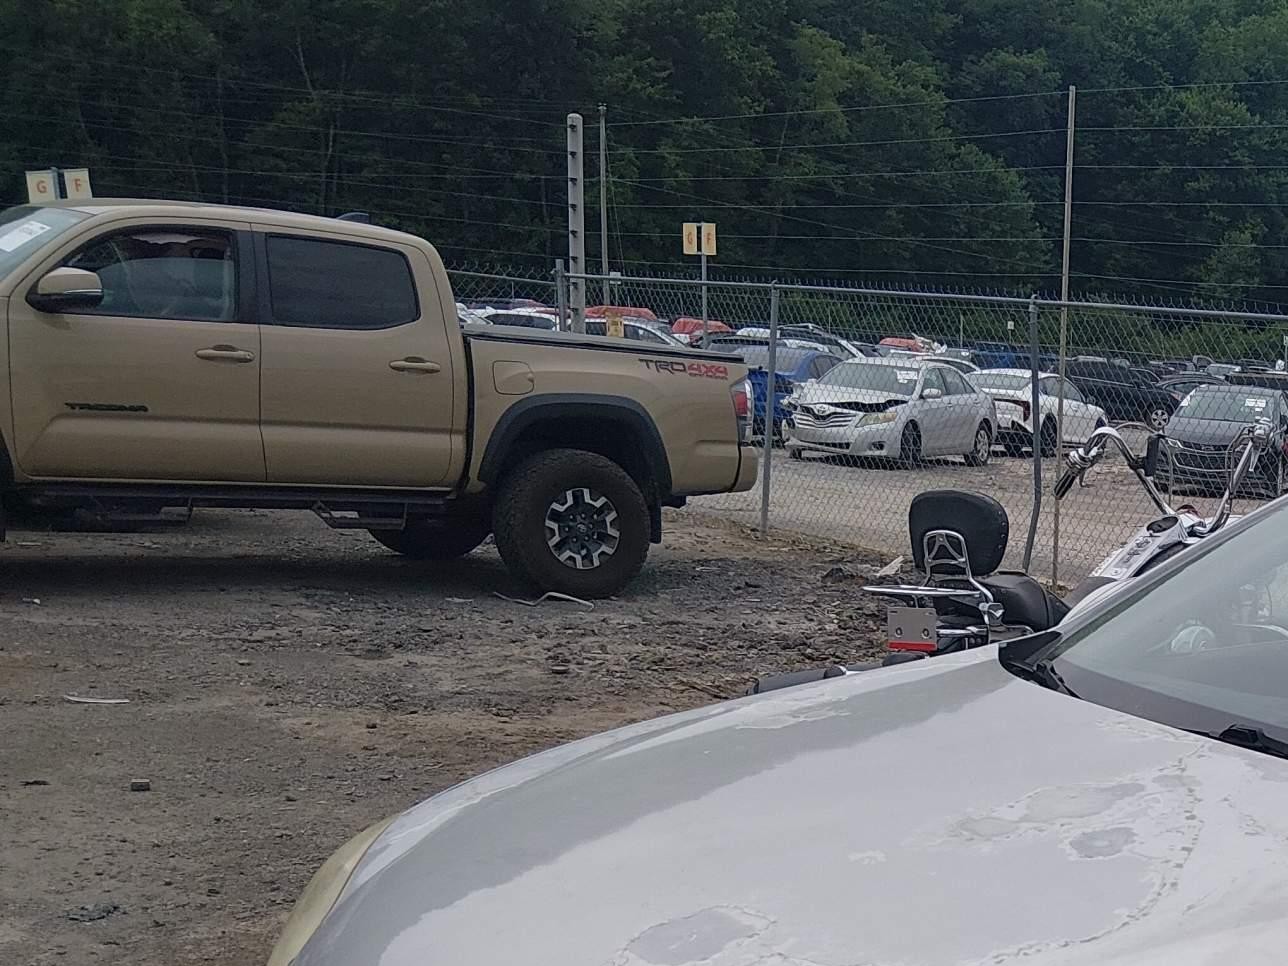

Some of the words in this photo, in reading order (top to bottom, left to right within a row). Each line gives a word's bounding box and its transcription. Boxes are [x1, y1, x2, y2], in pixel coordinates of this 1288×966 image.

[35, 180, 49, 194] G
[74, 178, 83, 193] F
[638, 358, 687, 375] TRD
